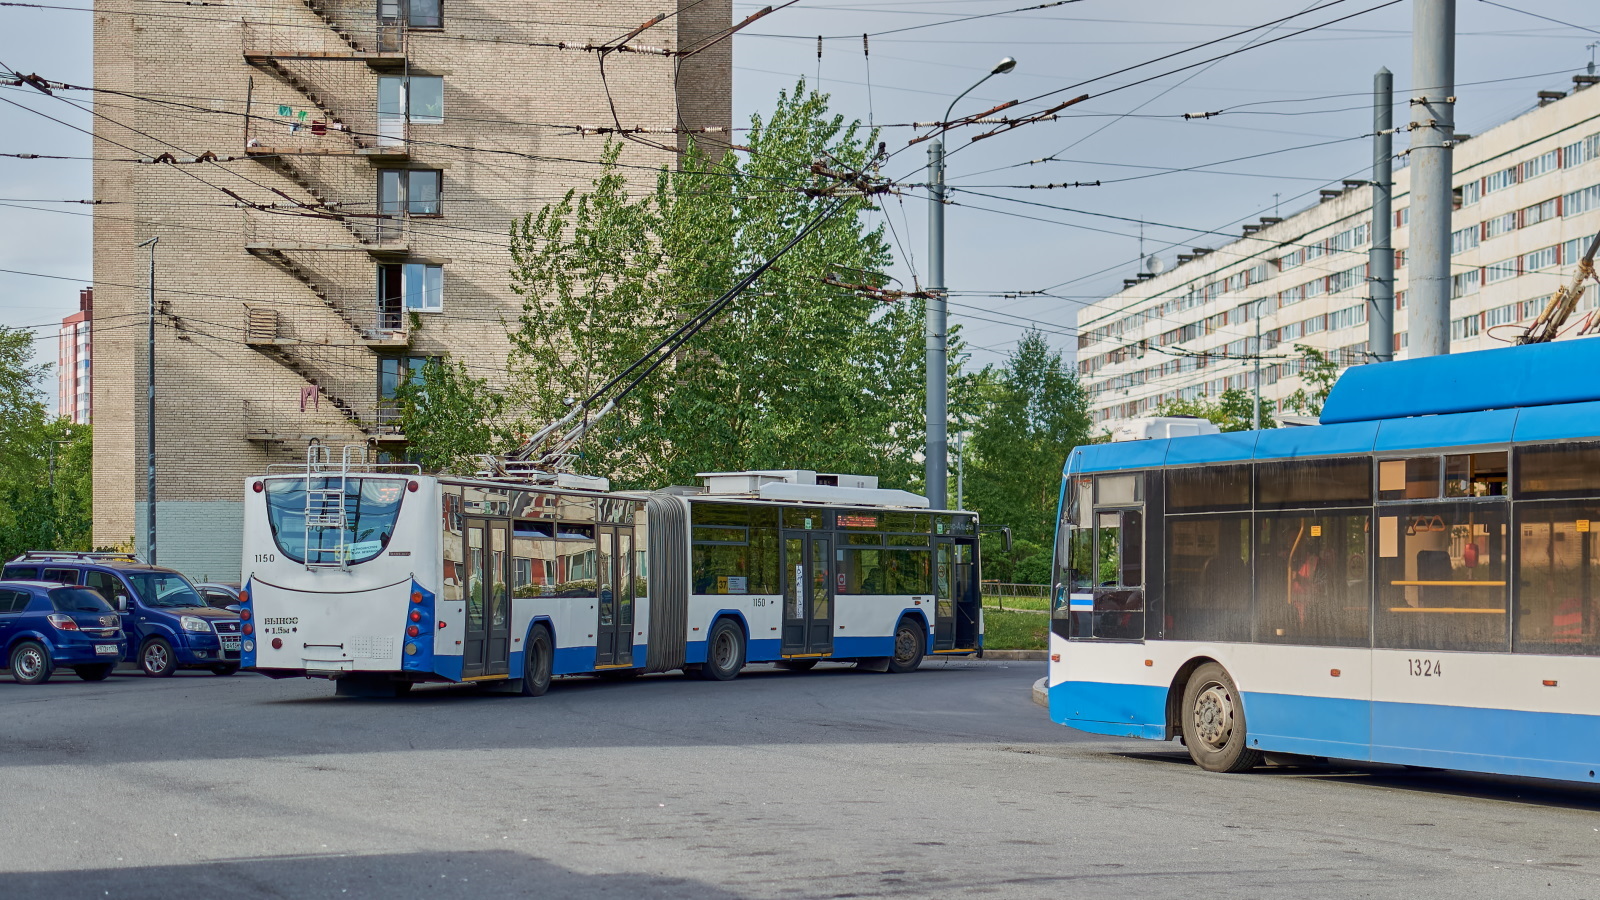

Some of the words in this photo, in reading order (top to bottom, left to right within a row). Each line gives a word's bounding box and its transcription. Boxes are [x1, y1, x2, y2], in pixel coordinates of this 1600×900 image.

[254, 553, 275, 563] 1150
[718, 580, 727, 589] 37
[753, 598, 766, 607] 1150
[1408, 658, 1442, 678] 1324
